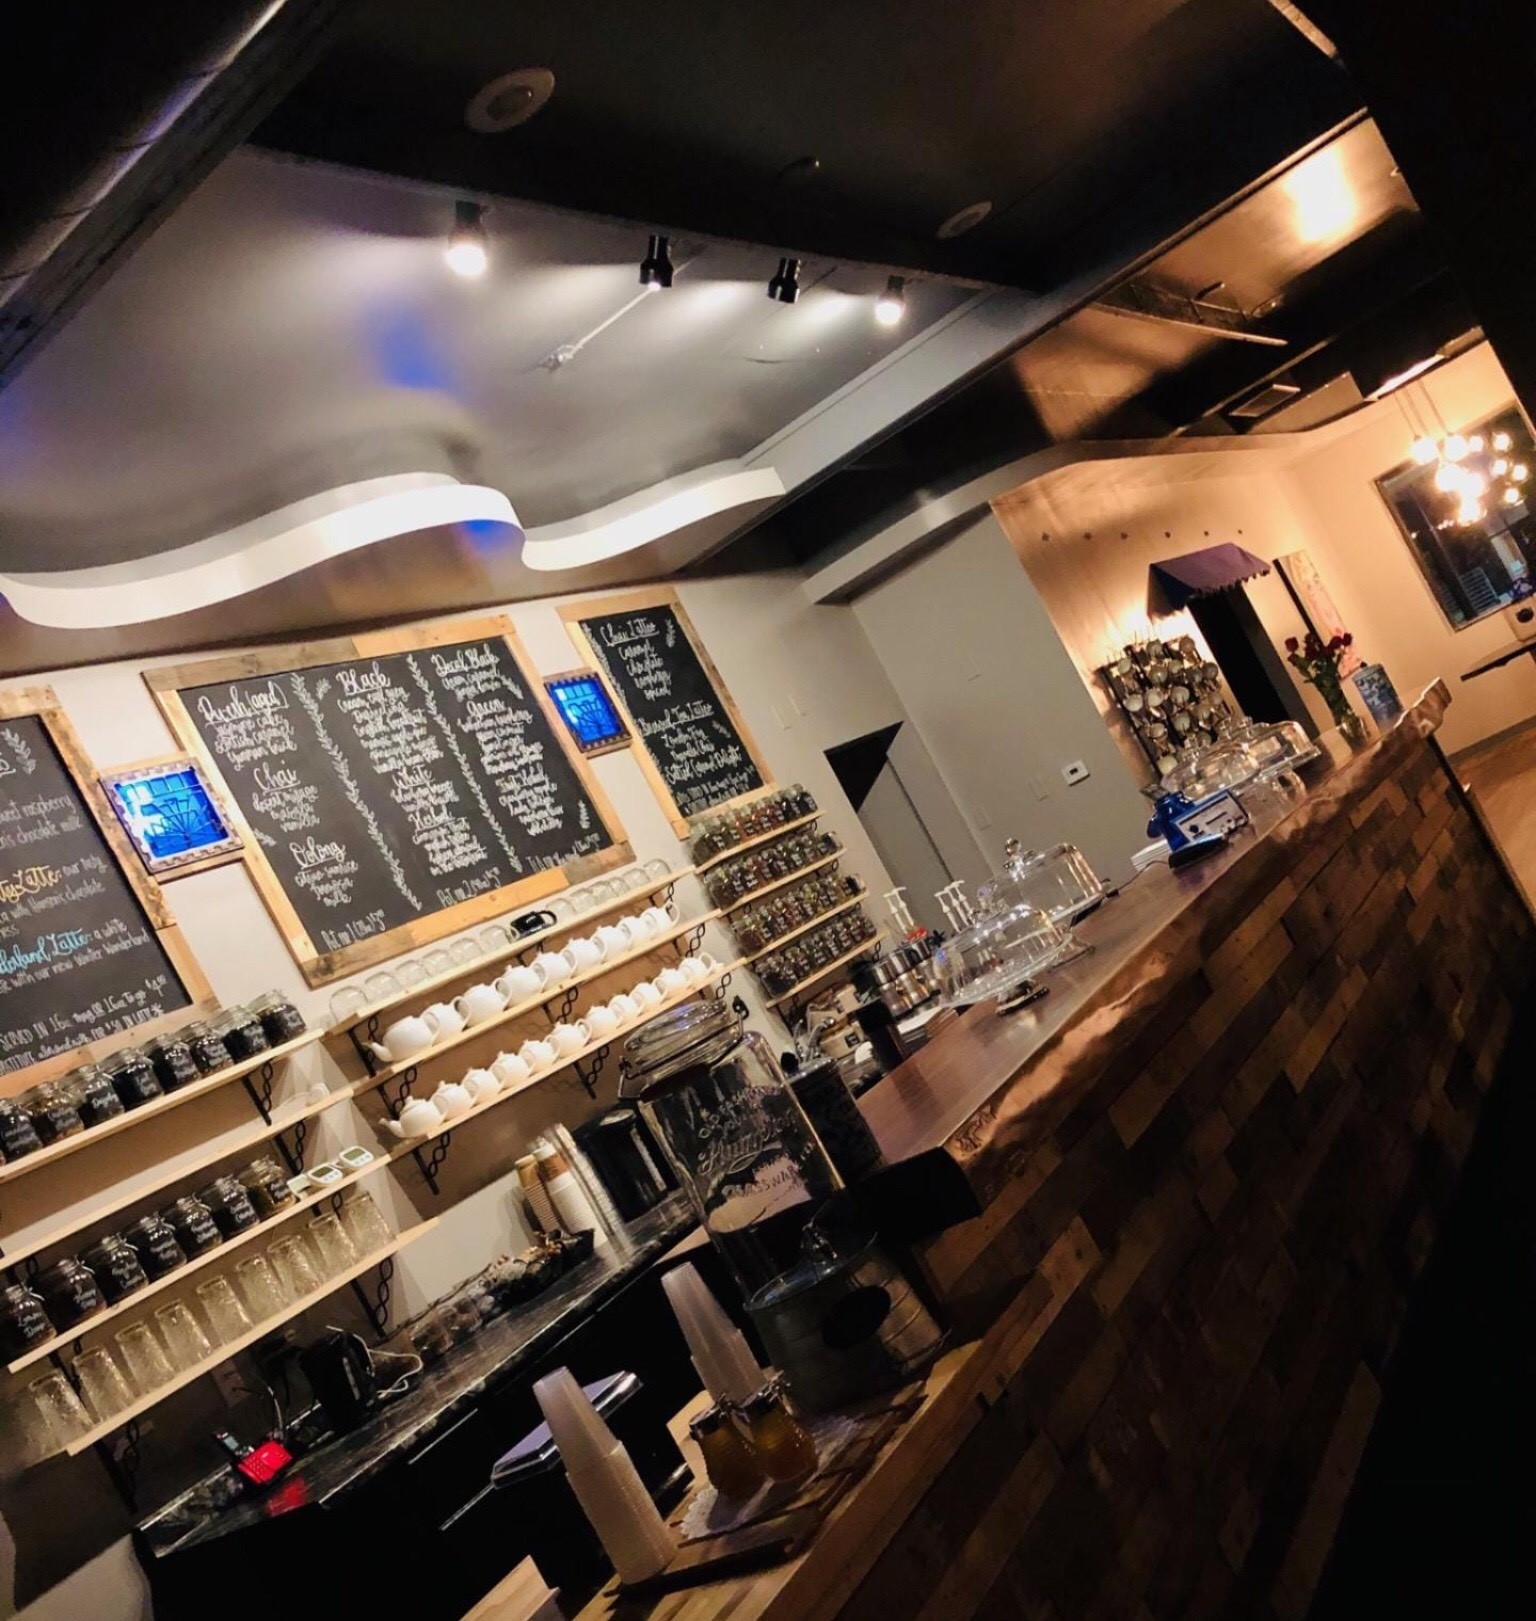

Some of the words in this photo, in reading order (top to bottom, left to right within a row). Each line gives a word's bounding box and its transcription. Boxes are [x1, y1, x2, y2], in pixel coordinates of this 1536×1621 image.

[337, 663, 389, 693] Black
[254, 761, 296, 789] Chai
[22, 795, 75, 821] raspberry
[290, 838, 344, 872] Oolong
